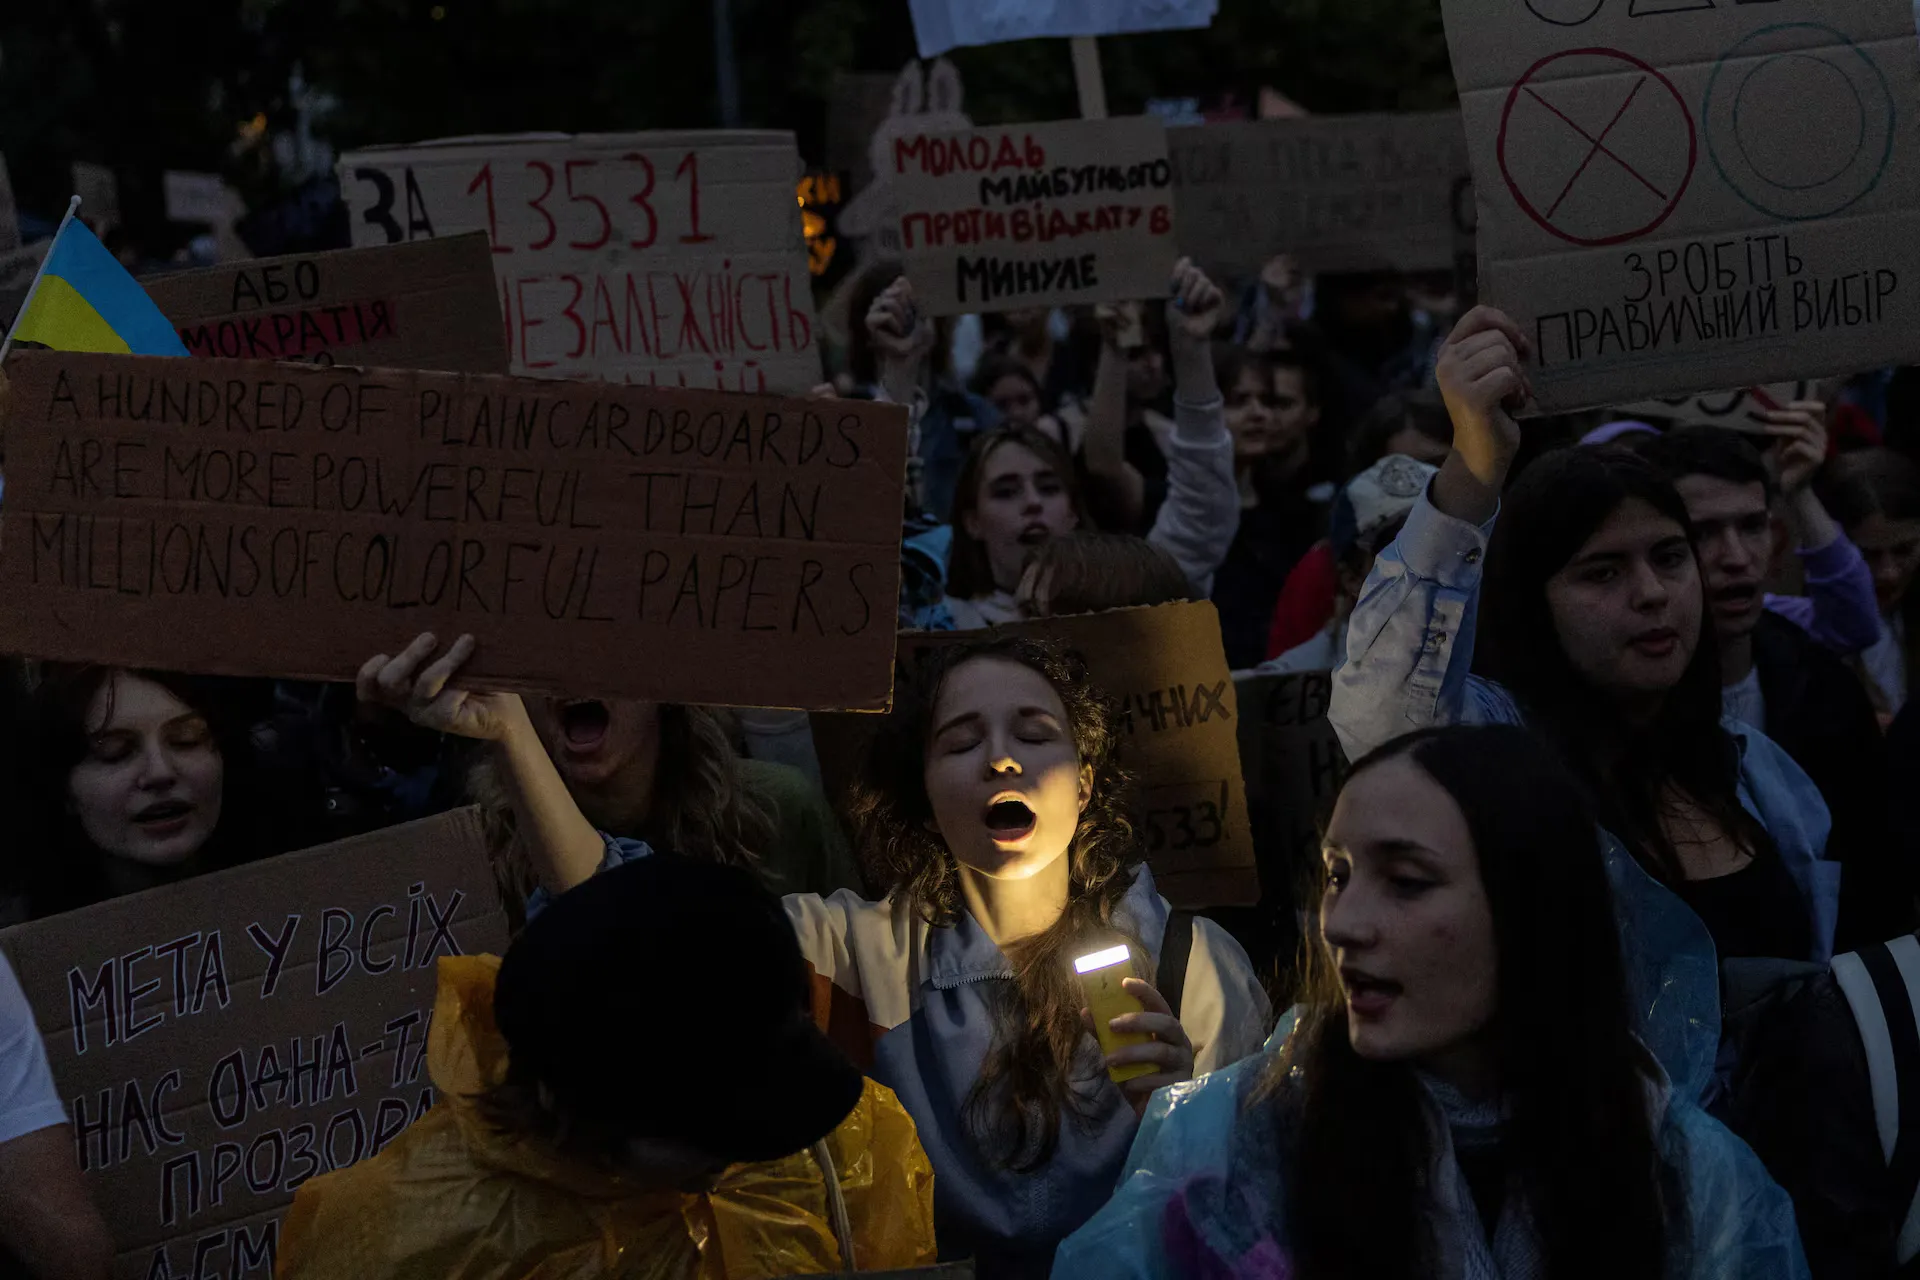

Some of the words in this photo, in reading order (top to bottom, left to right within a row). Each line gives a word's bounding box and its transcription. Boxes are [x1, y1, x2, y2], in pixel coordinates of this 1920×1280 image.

[895, 133, 1045, 177] МОЛОДЬ
[981, 158, 1171, 205] МАЙБУТНЬОГО
[356, 166, 435, 244] ЗА
[467, 151, 715, 253] 13531
[903, 208, 1006, 249] ПРОТИ
[1149, 205, 1171, 235] В
[232, 260, 320, 312] АБО
[957, 253, 1098, 303] МИНУЛЕ
[1624, 234, 1803, 303] ЗРОБІТЬ
[1535, 284, 1779, 367] ПРАВИЛЬНИЙ
[1794, 267, 1898, 333] ВИБІР
[48, 368, 81, 422] A
[98, 372, 305, 435] HUNDRED
[320, 382, 395, 435] OF
[49, 439, 147, 500] ARE
[628, 472, 821, 542] THAN
[638, 549, 875, 637] PAPERS
[66, 929, 232, 1056] МЕТА
[246, 914, 301, 1000] У
[73, 1069, 185, 1172] НАС
